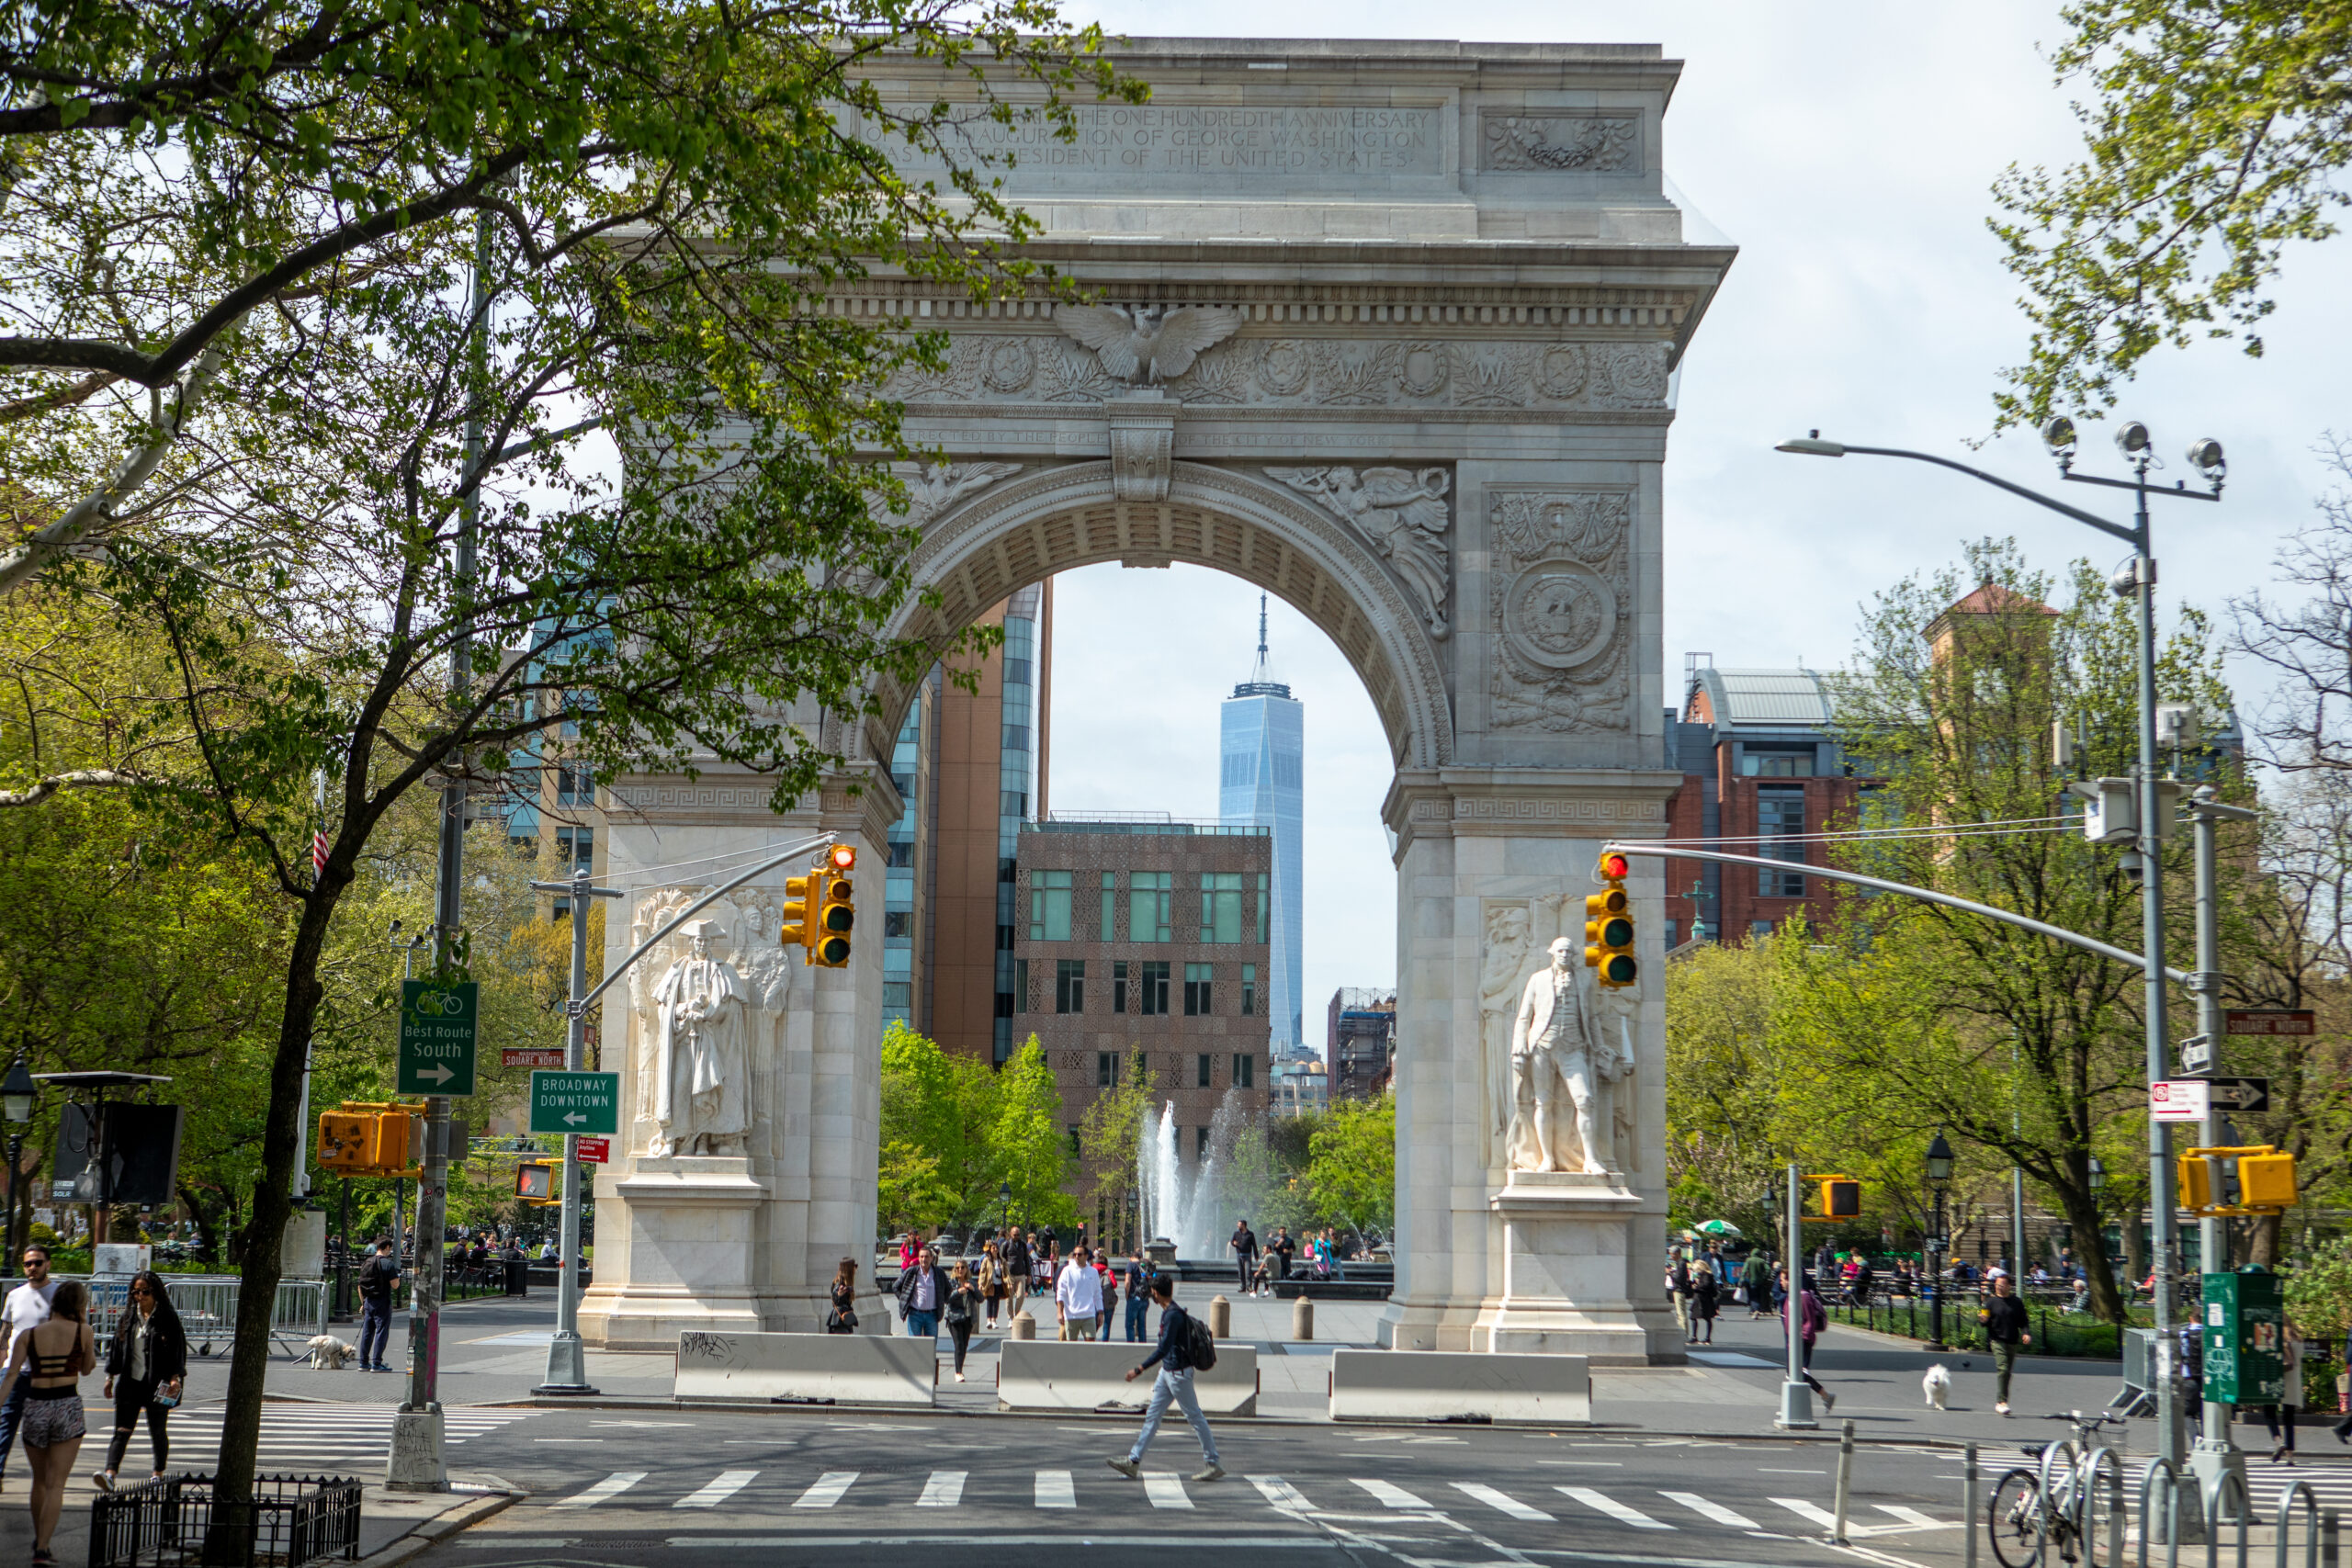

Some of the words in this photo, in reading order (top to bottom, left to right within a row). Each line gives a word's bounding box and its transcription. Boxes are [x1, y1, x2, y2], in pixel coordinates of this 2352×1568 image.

[1113, 109, 1156, 127] ONE
[1161, 109, 1285, 128] HUNDREDTH
[1288, 111, 1430, 130] ANNIVERSARY
[956, 127, 1124, 145] INAUGURION
[1134, 129, 1163, 147] OF
[1171, 130, 1260, 147] GEORGE
[1271, 130, 1426, 149] WASHINGTON
[993, 147, 1112, 165] PRESIDENT
[1122, 149, 1152, 166] OF
[1163, 150, 1210, 167] THE
[1221, 150, 1306, 167] UNITED
[404, 1026, 432, 1037] Best
[436, 1026, 472, 1038] Route
[2229, 1020, 2269, 1033] SQUARE
[2275, 1021, 2310, 1033] NORTH
[413, 1042, 461, 1057] South
[506, 1056, 535, 1066] SQUARE
[538, 1056, 561, 1066] NORTH
[542, 1078, 607, 1091] BROADWAY
[540, 1095, 609, 1108] DOWNTOWN
